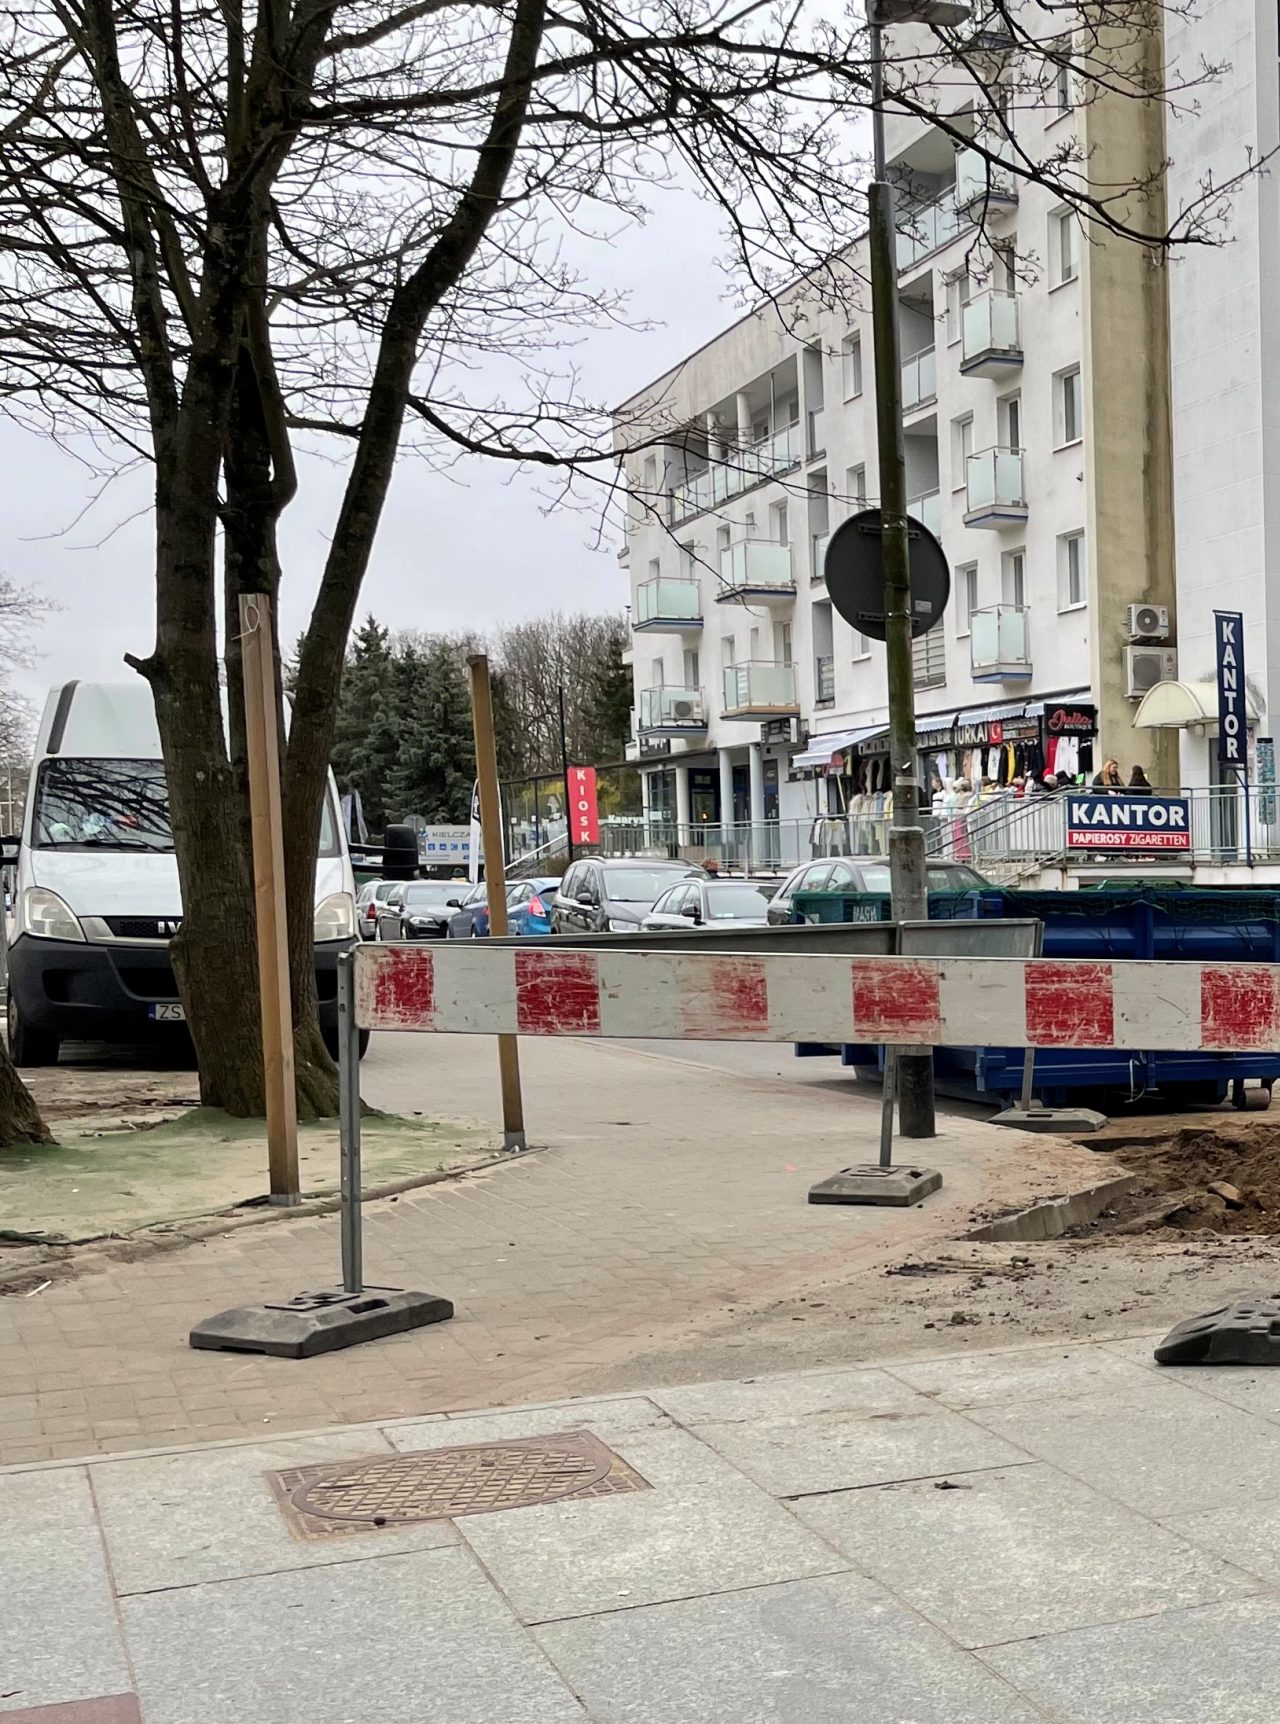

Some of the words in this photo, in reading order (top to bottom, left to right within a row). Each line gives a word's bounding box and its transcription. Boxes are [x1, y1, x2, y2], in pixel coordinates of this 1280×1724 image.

[1222, 621, 1239, 759] KANTOR
[576, 769, 591, 842] KIOSK
[1072, 803, 1186, 827] KANTOR
[1072, 832, 1127, 845] PAPIEROSY
[1129, 832, 1187, 845] ZIGARETTEN
